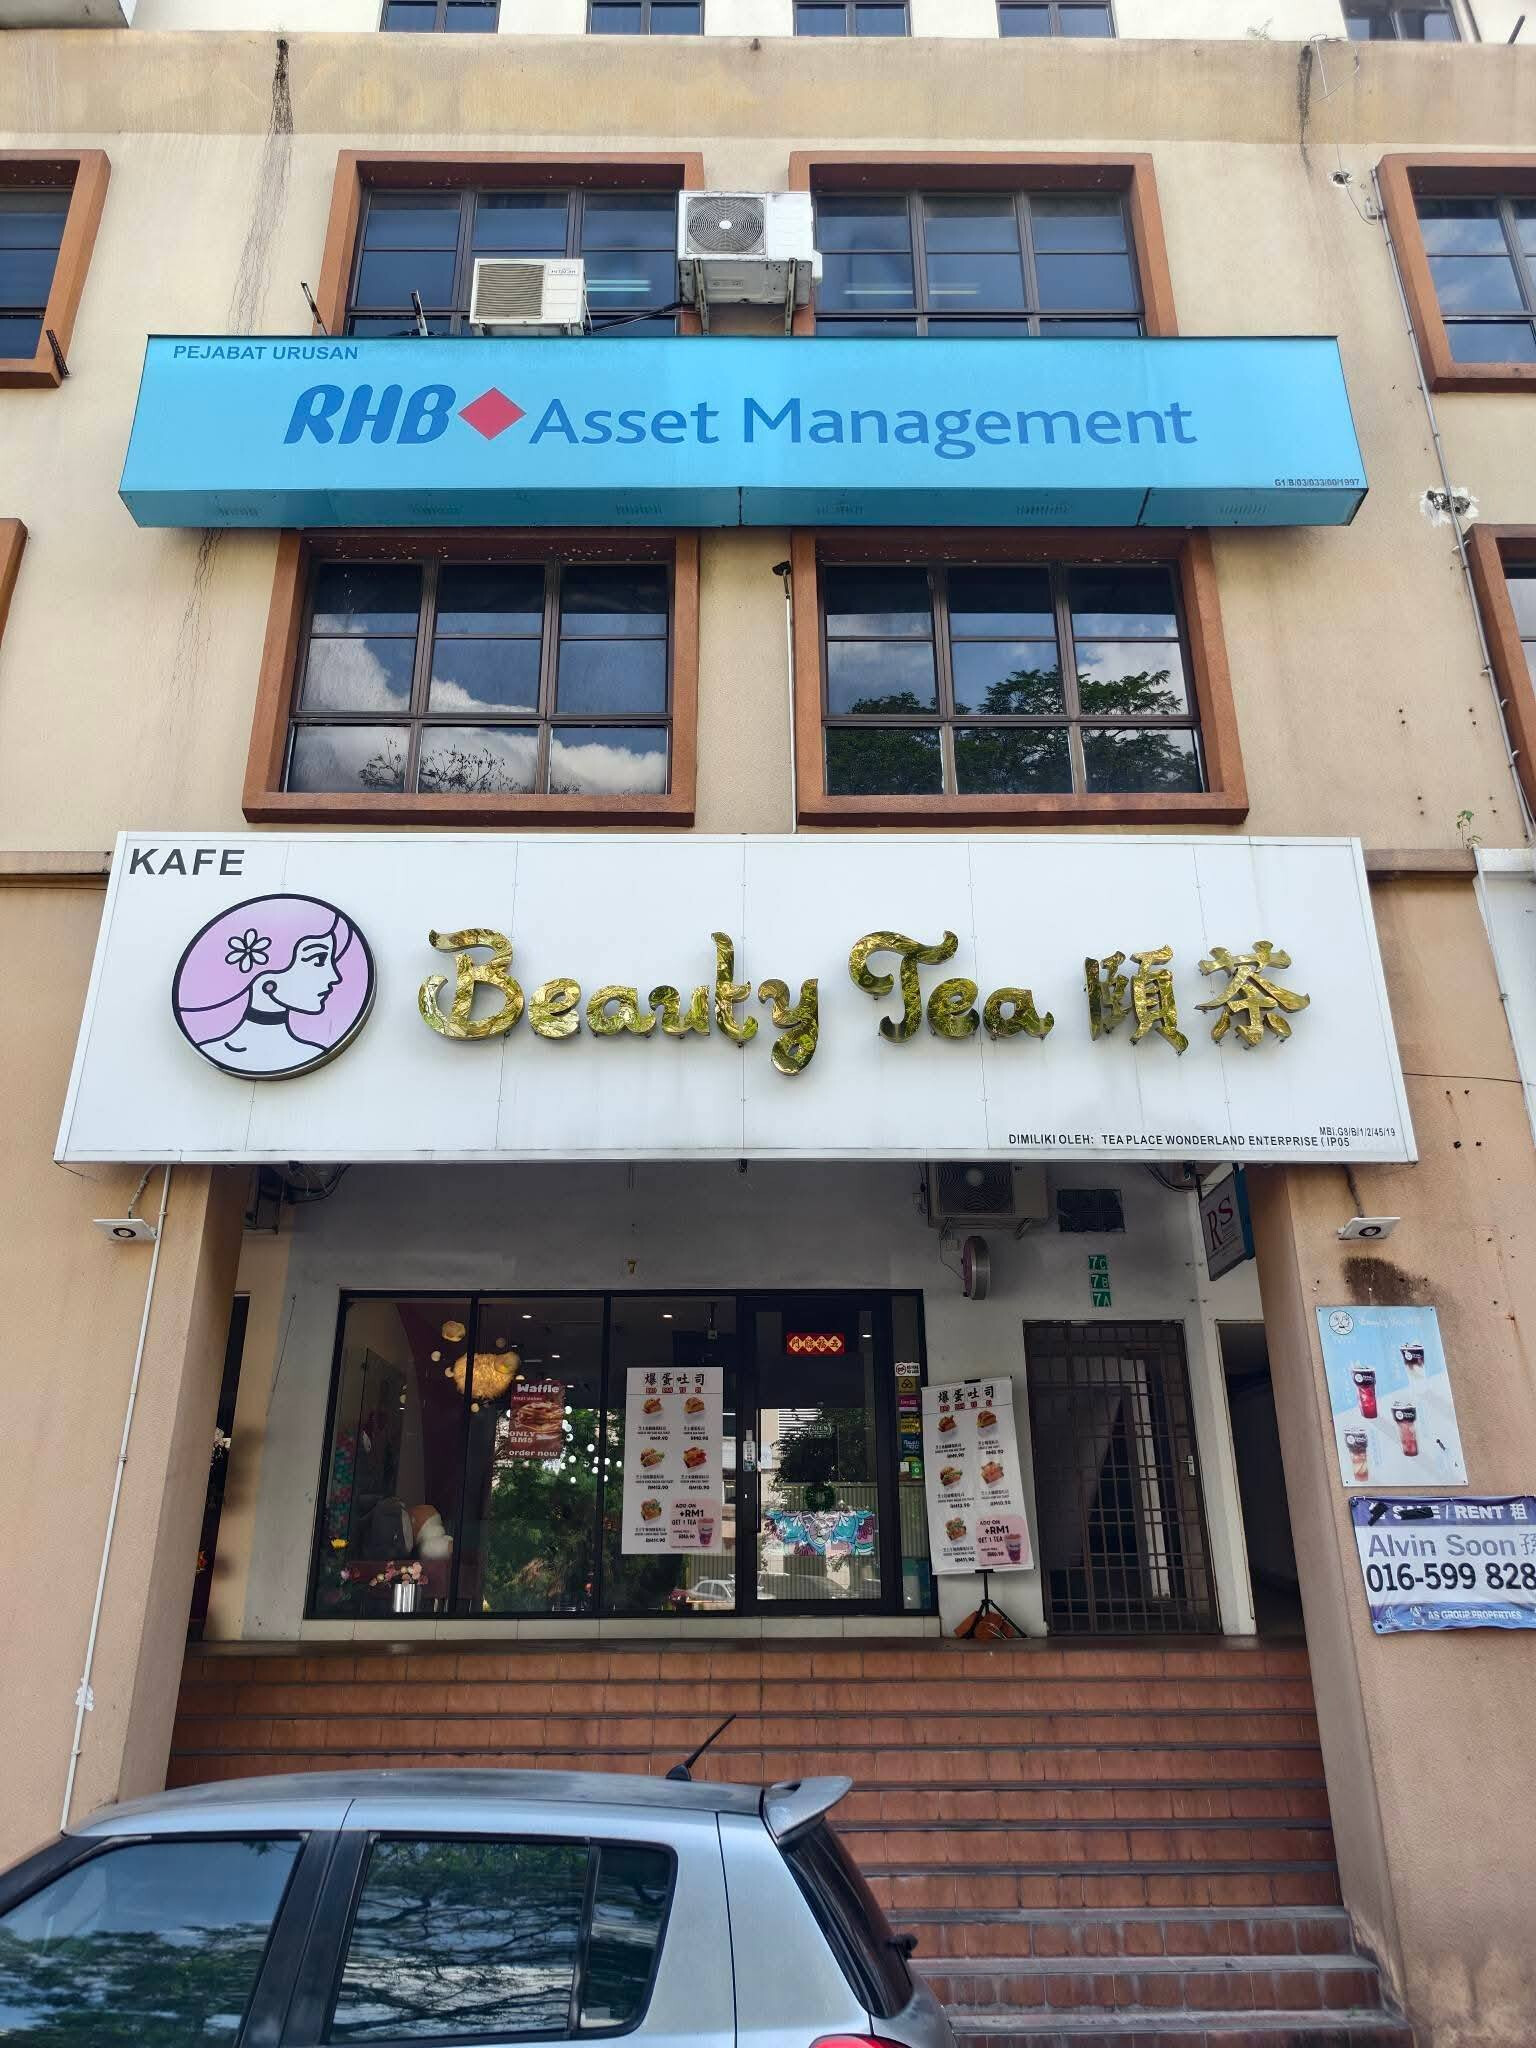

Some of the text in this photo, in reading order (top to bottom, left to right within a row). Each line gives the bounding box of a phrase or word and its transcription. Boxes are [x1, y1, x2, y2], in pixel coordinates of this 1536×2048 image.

[173, 345, 359, 361] PEJABAT URUSAN
[284, 383, 1198, 460] RHB Asset Management
[128, 848, 246, 877] KAFE
[417, 927, 1056, 1077] Beauty Tea
[1008, 1133, 1056, 1145] DIMILIKI
[1058, 1134, 1095, 1145] OLEH:
[1102, 1134, 1124, 1145] TEA
[1126, 1134, 1163, 1145] PLACE
[1165, 1134, 1245, 1146] WONDERLAND
[1249, 1136, 1318, 1147] ENTERPRISE
[1089, 1256, 1106, 1270] 7C
[1091, 1274, 1108, 1288] 7B
[1093, 1293, 1110, 1307] 7A
[645, 1372, 705, 1386] 爆蛋吐司
[517, 1383, 560, 1393] Waffle
[937, 1385, 994, 1404] 爆蛋吐司
[680, 1509, 704, 1517] +RM1
[1392, 1505, 1441, 1520] SE
[1455, 1505, 1504, 1520] RENT
[1510, 1503, 1528, 1520] 租
[984, 1525, 1010, 1535] +RM1
[993, 1535, 1004, 1543] TEA
[1368, 1533, 1437, 1558] Alvin
[1446, 1533, 1516, 1557] Soon
[1366, 1562, 1477, 1593] 016-599
[1441, 1610, 1471, 1619] GROUP
[1472, 1610, 1522, 1619] PROPERTIES
